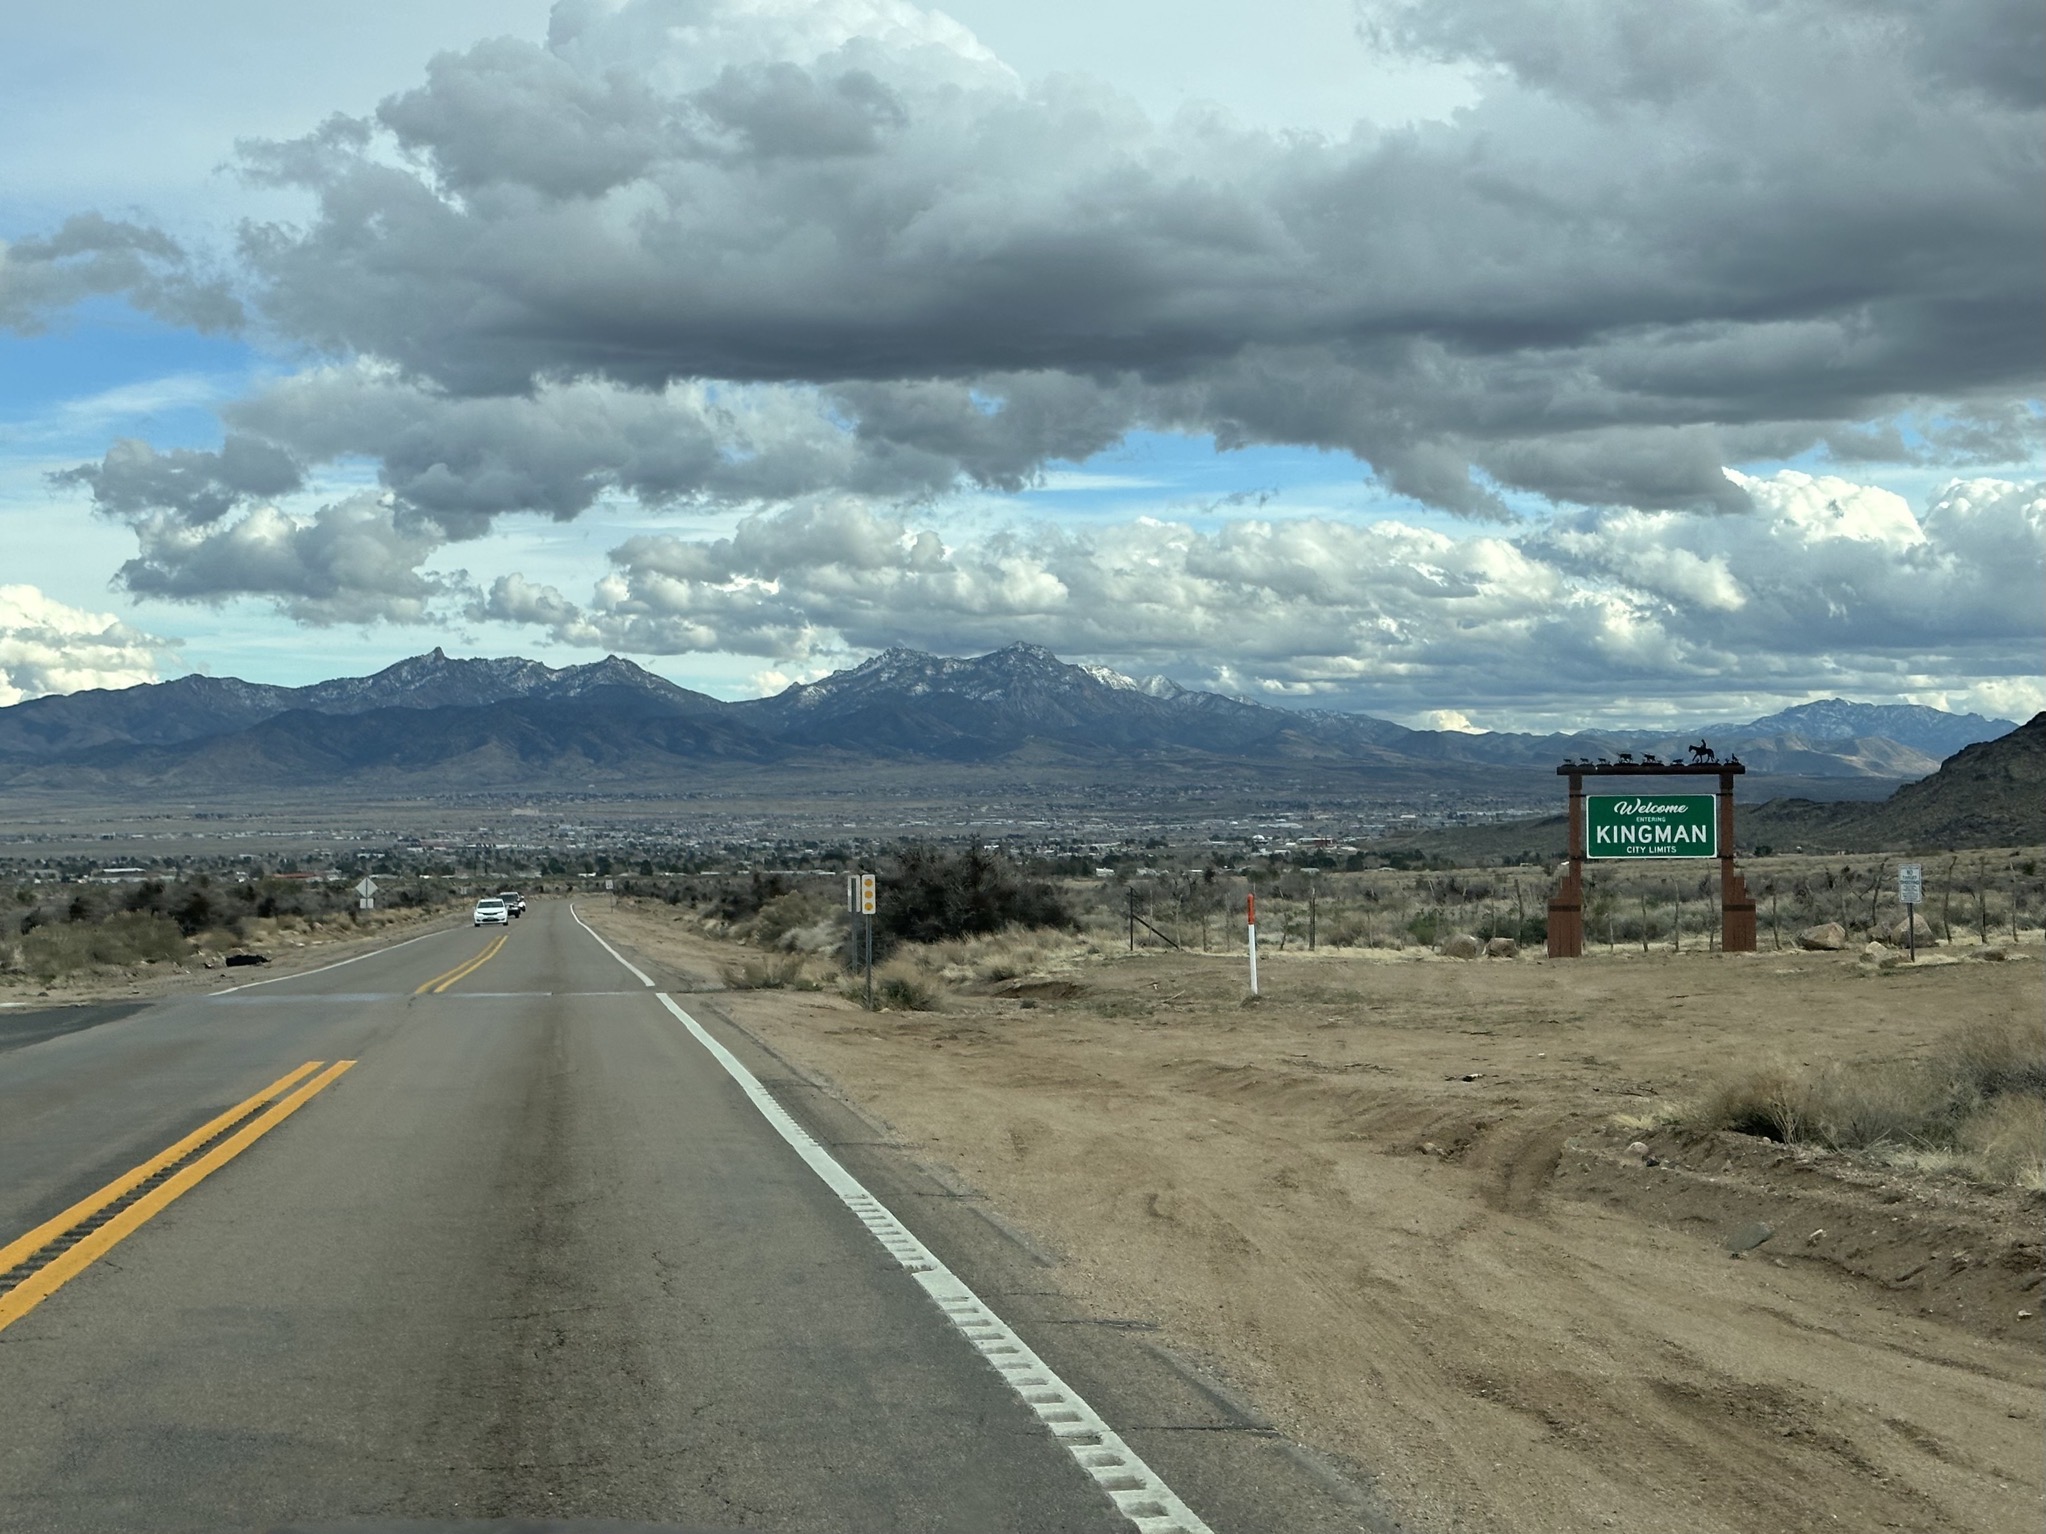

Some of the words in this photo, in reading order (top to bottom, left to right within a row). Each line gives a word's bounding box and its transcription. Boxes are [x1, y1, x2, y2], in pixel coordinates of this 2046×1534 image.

[1613, 798, 1688, 815] Welcome
[1596, 825, 1707, 844] KINGMAN
[1626, 845, 1646, 854] CITY
[1649, 845, 1677, 854] LIMITS
